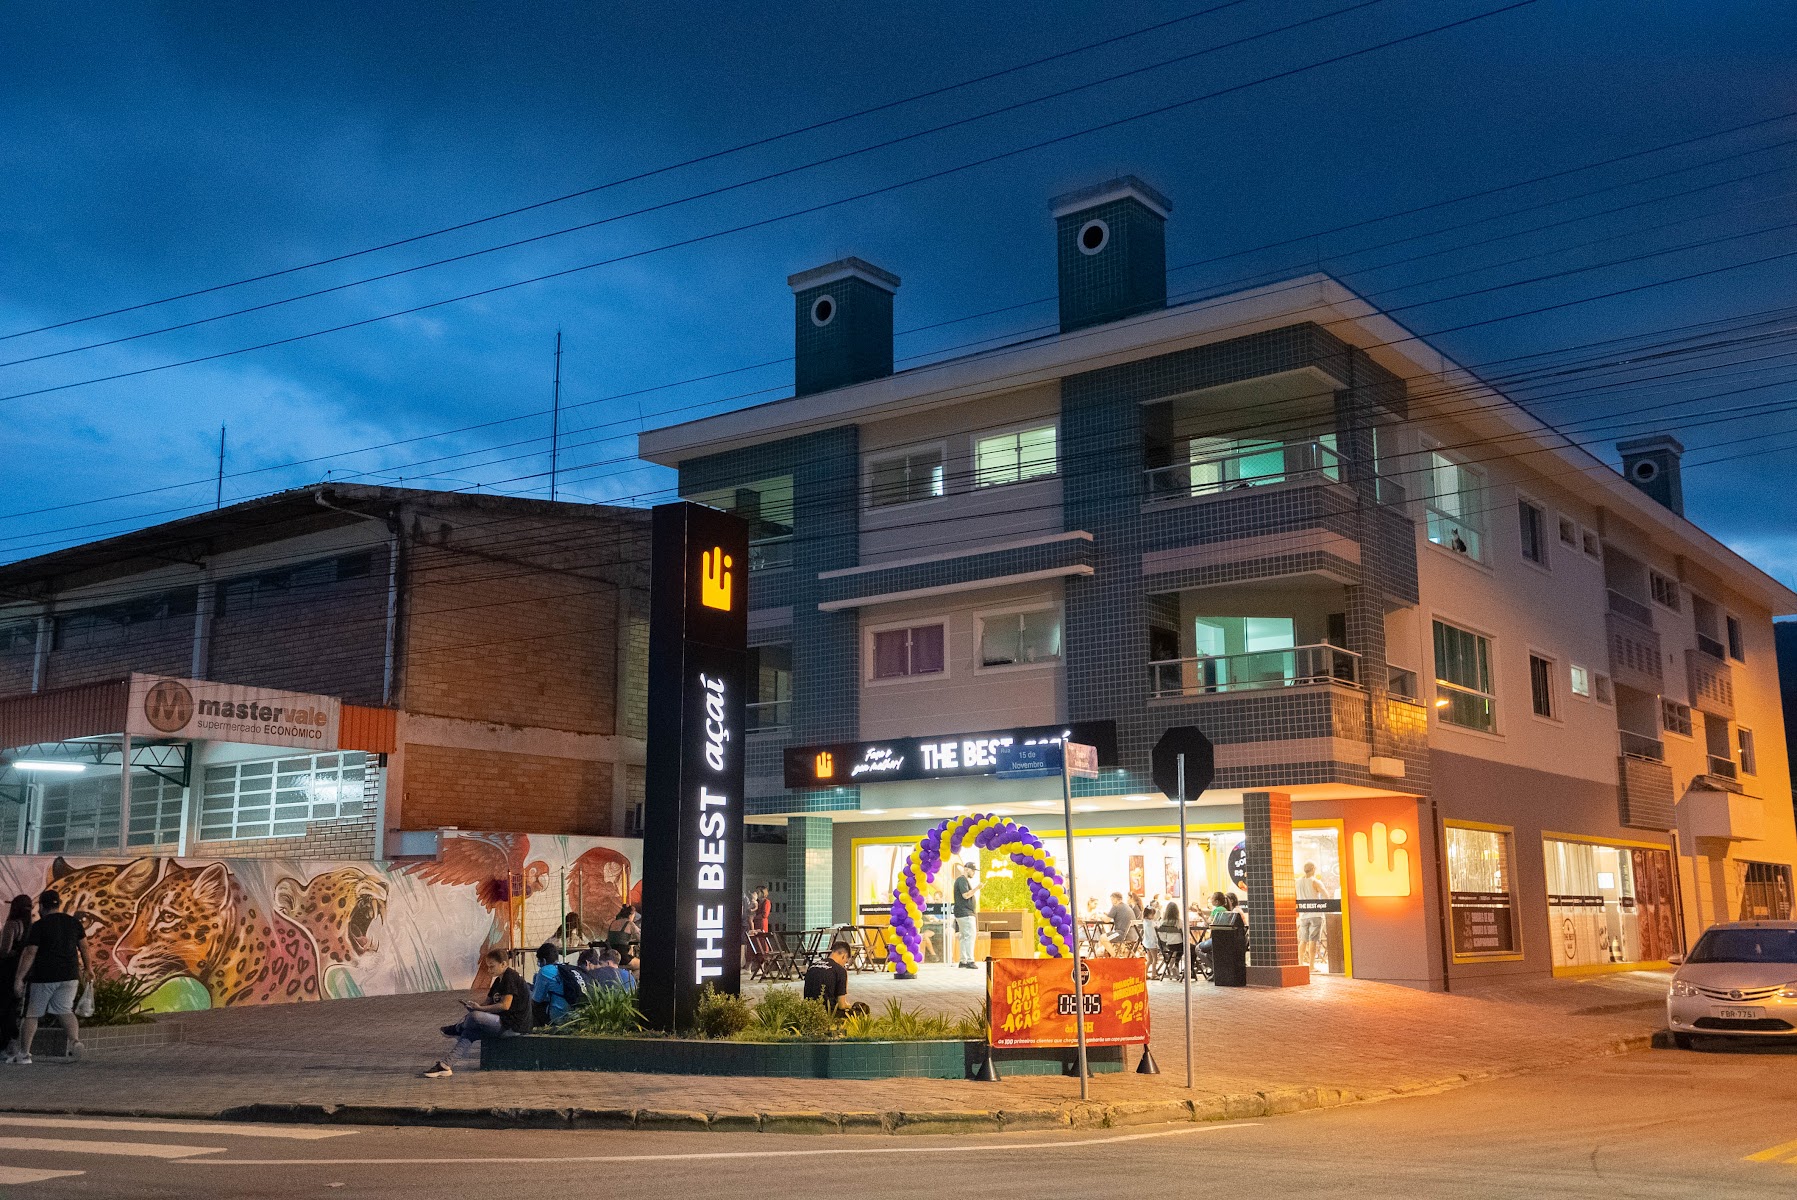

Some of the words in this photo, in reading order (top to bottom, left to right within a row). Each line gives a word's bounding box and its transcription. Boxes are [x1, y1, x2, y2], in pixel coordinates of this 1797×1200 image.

[198, 700, 327, 727] mastervale
[699, 672, 731, 771] açaí
[198, 720, 261, 734] supermercado
[264, 724, 322, 740] ECONÔMICO
[920, 742, 959, 770] THE
[1012, 760, 1044, 770] Novembro
[1018, 751, 1027, 759] 15
[1027, 750, 1036, 759] de
[698, 787, 727, 889] BEST
[696, 904, 724, 985] THE
[1011, 975, 1038, 989] GRANDE
